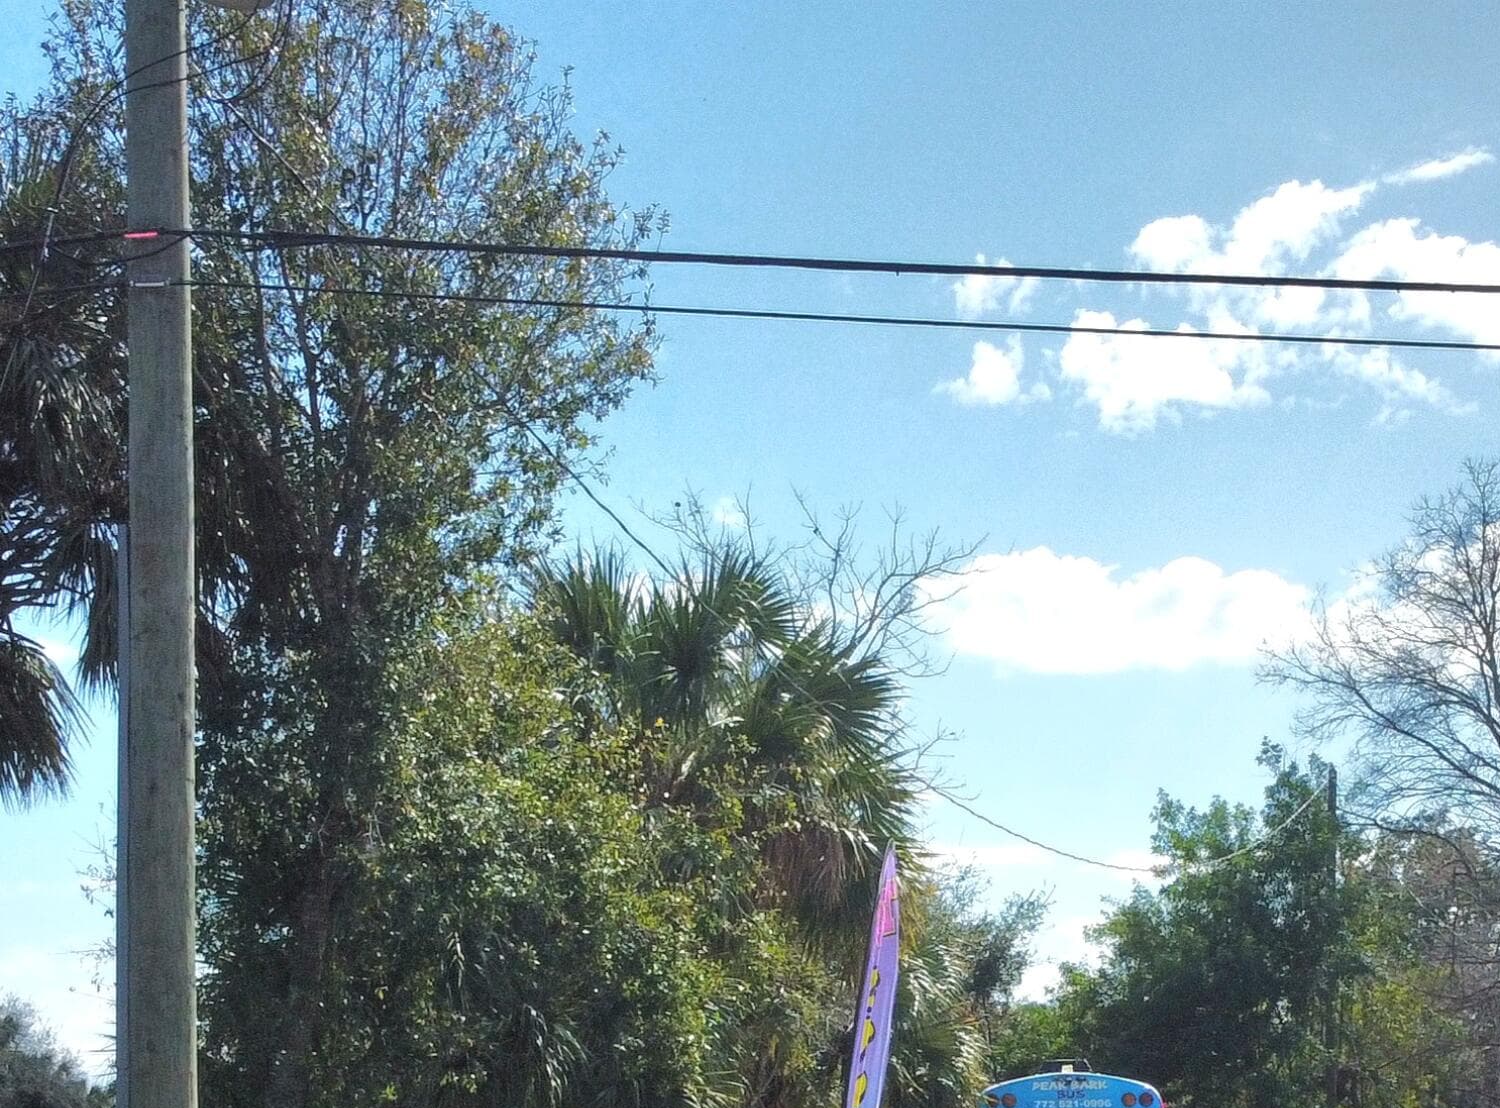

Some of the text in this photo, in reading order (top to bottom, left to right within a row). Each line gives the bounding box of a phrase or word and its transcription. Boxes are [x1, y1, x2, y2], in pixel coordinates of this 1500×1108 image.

[1032, 1079, 1108, 1091] PEAK BARK
[1057, 1090, 1086, 1099] BUS
[1034, 1100, 1057, 1108] 772
